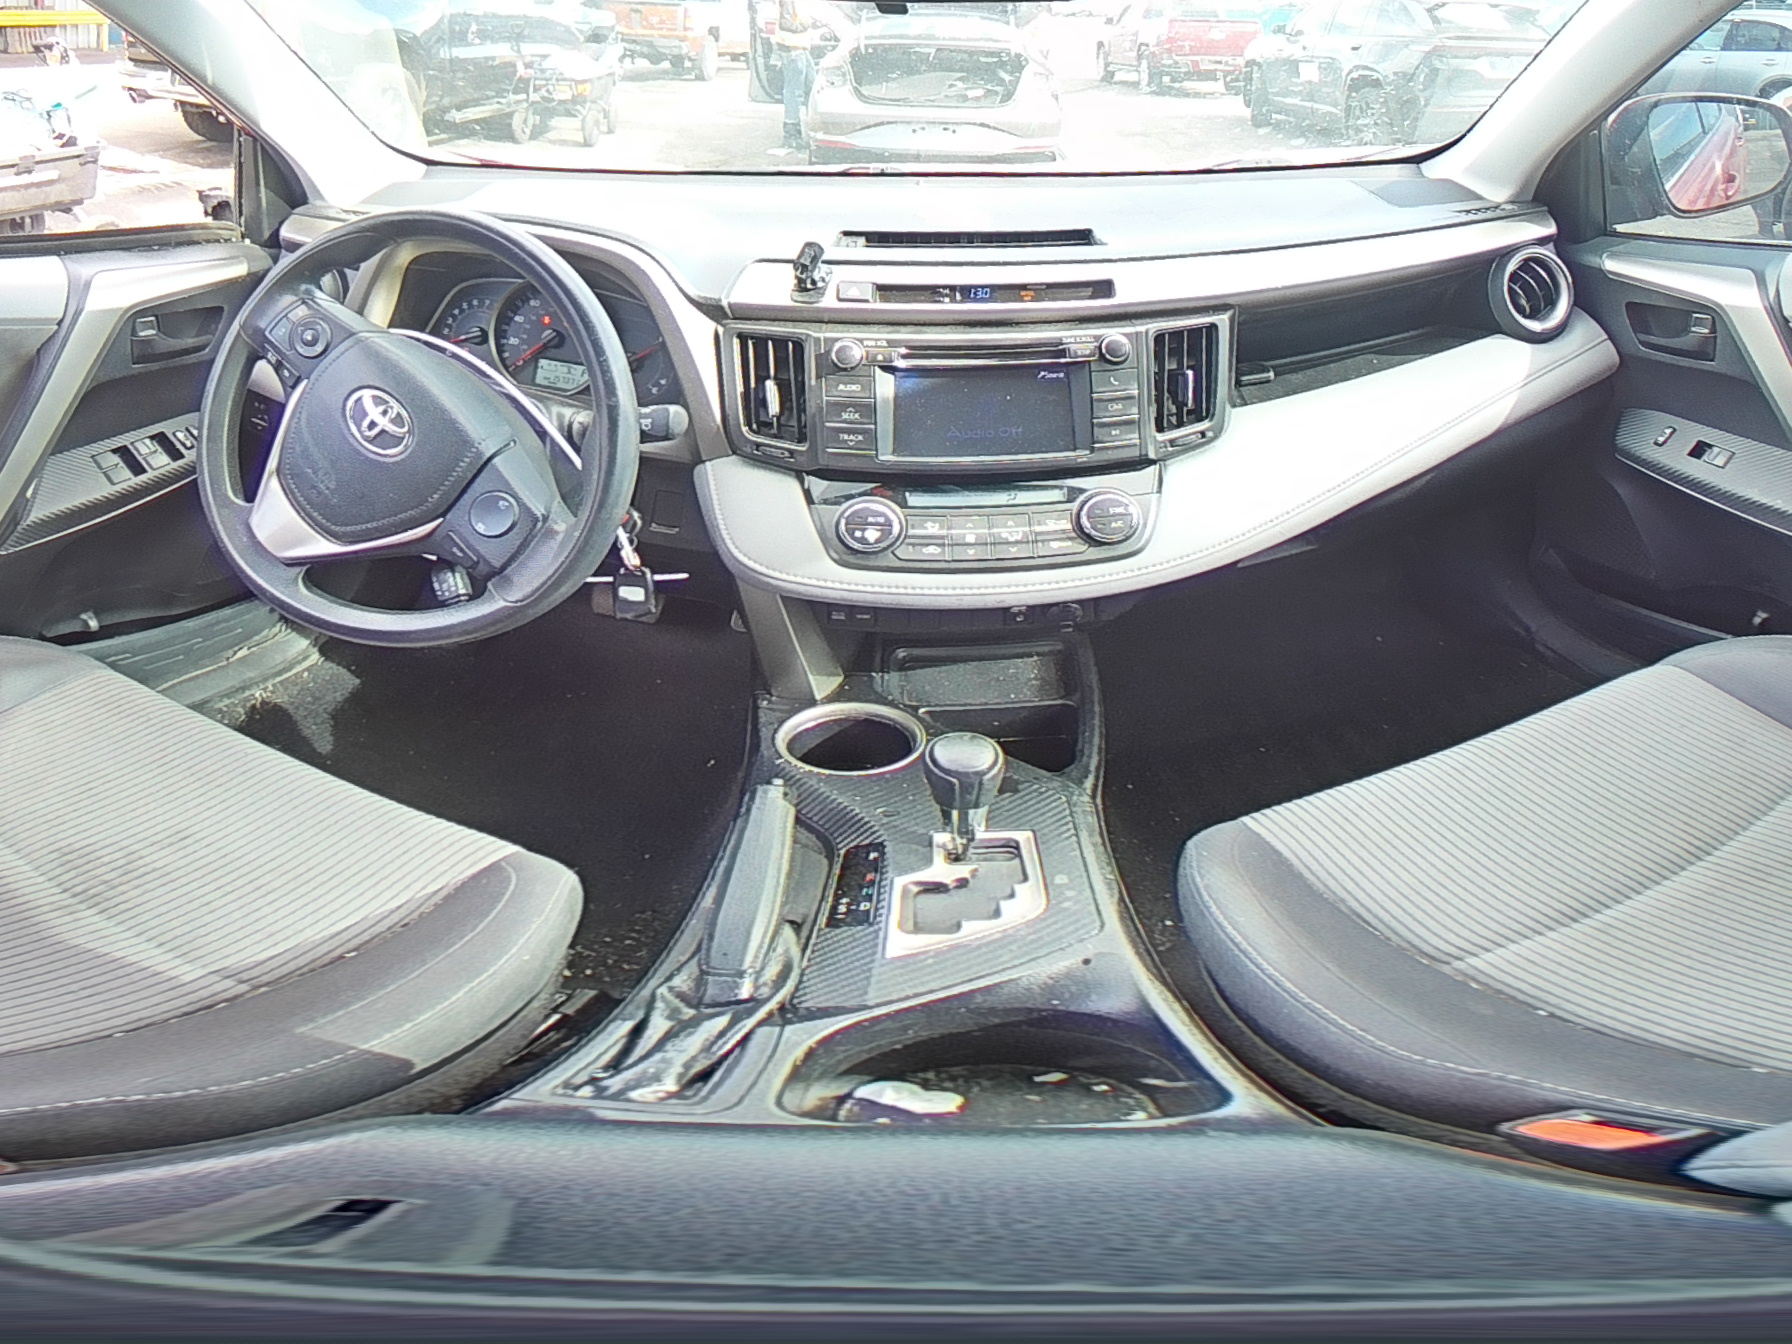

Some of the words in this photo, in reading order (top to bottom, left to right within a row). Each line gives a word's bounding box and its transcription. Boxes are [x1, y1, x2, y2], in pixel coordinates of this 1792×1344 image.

[837, 382, 862, 392] AUDIO
[841, 411, 861, 420] SEEK
[946, 425, 995, 439] Audio
[838, 433, 864, 442] TRACK
